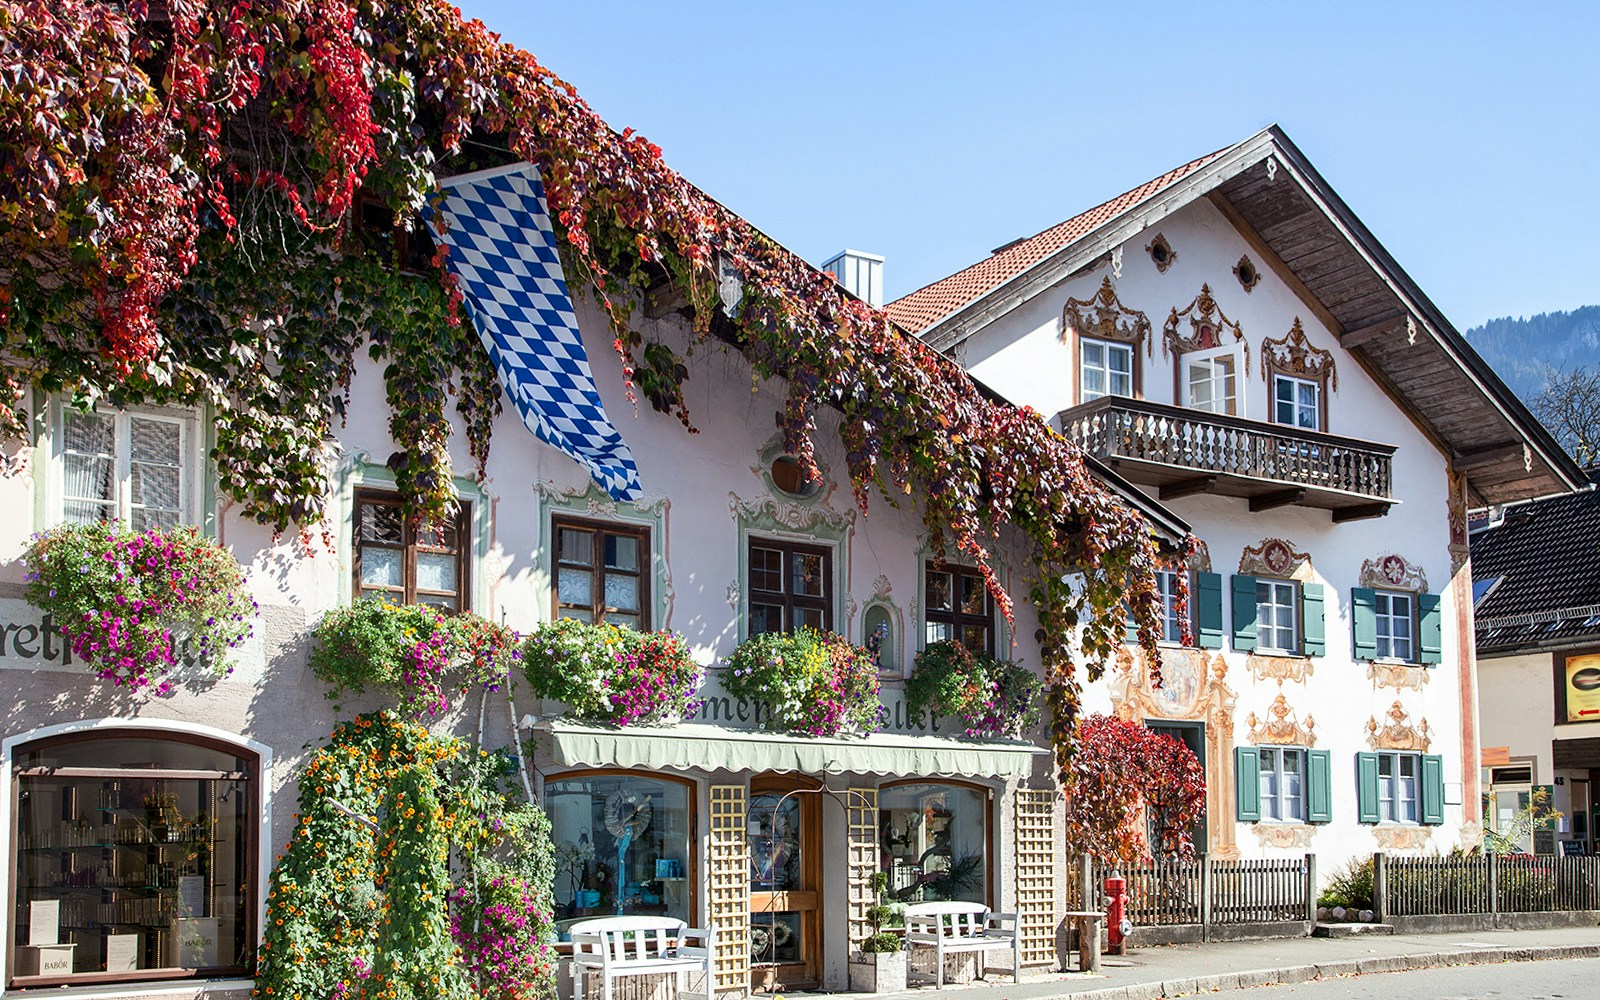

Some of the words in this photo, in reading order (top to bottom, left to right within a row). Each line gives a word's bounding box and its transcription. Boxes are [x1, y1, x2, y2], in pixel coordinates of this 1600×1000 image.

[691, 696, 772, 722] men
[879, 700, 943, 732] eller
[1554, 776, 1565, 786] 45
